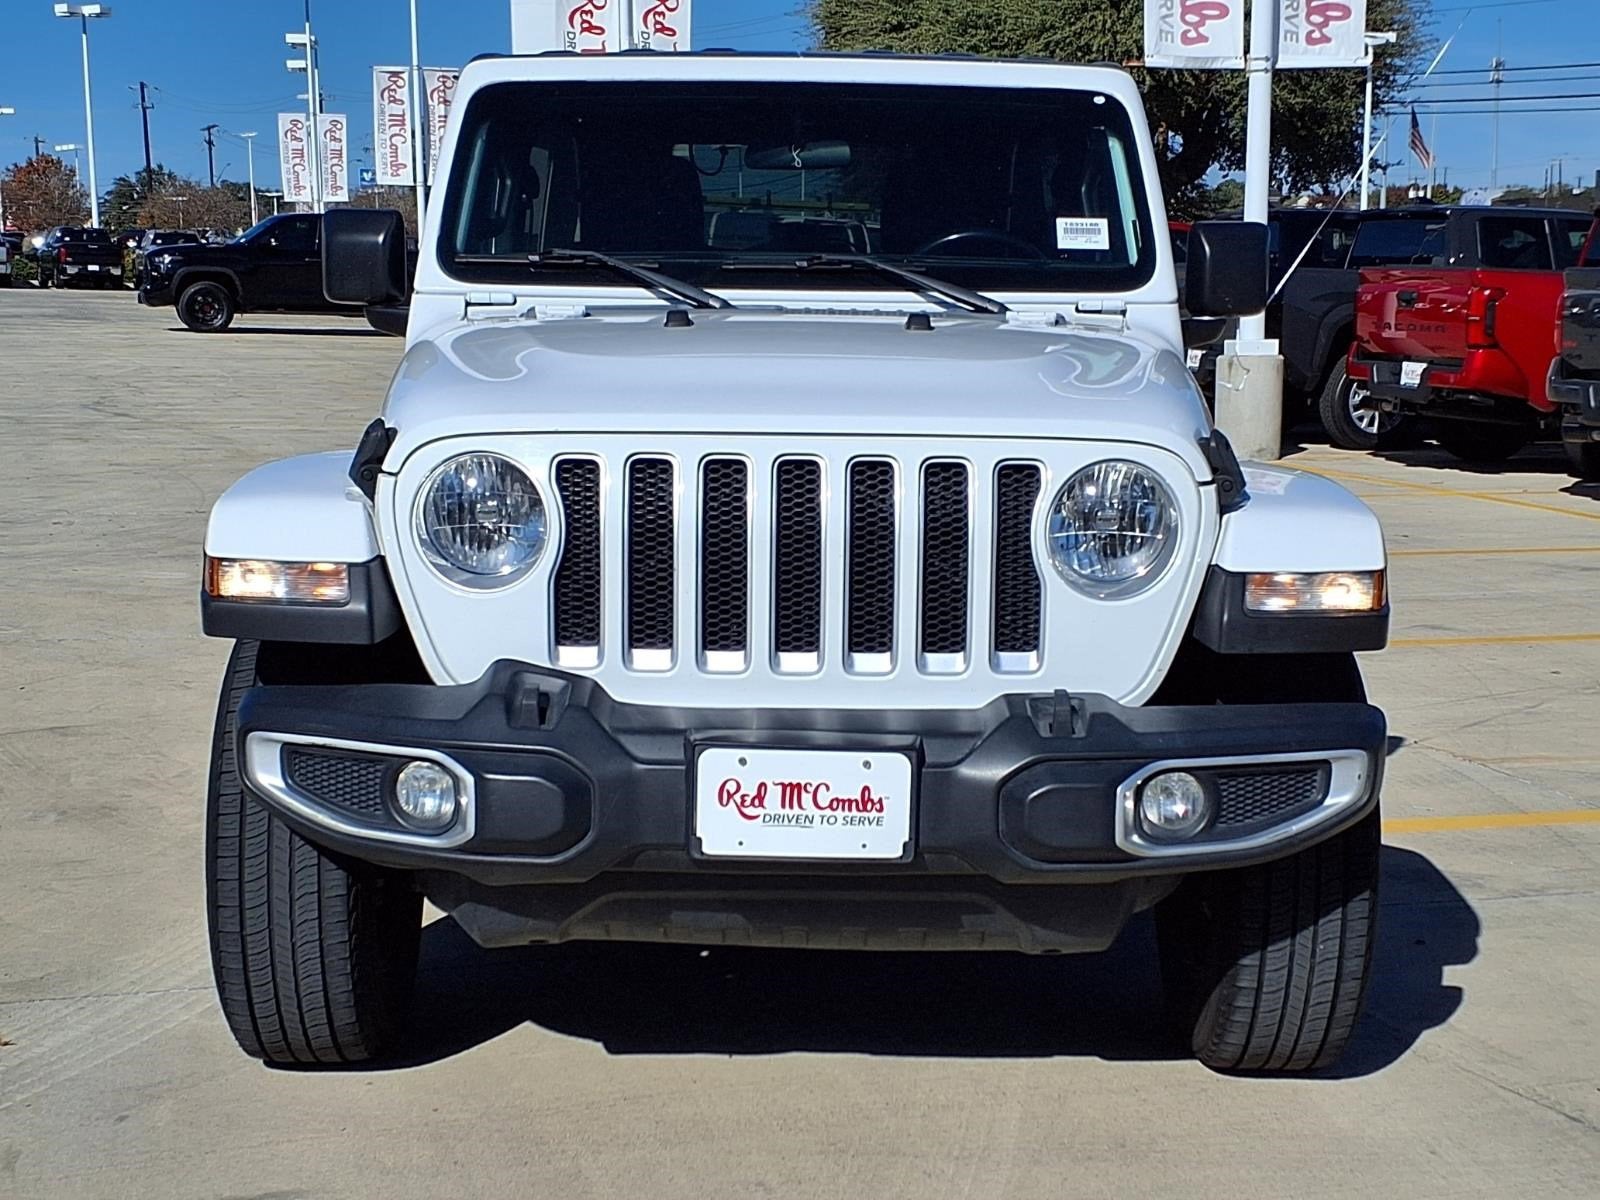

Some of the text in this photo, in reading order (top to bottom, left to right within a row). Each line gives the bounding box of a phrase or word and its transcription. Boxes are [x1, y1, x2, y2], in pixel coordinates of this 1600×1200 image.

[1159, 0, 1175, 44] RVE
[1284, 0, 1299, 44] RVE
[284, 119, 304, 143] Red
[380, 135, 387, 149] TO
[381, 73, 407, 177] Red McCombs
[291, 145, 306, 197] McCombs
[324, 120, 344, 197] Red McCombs
[718, 778, 884, 821] Red McCombs
[762, 813, 885, 827] DRIVEN TO SERVE
